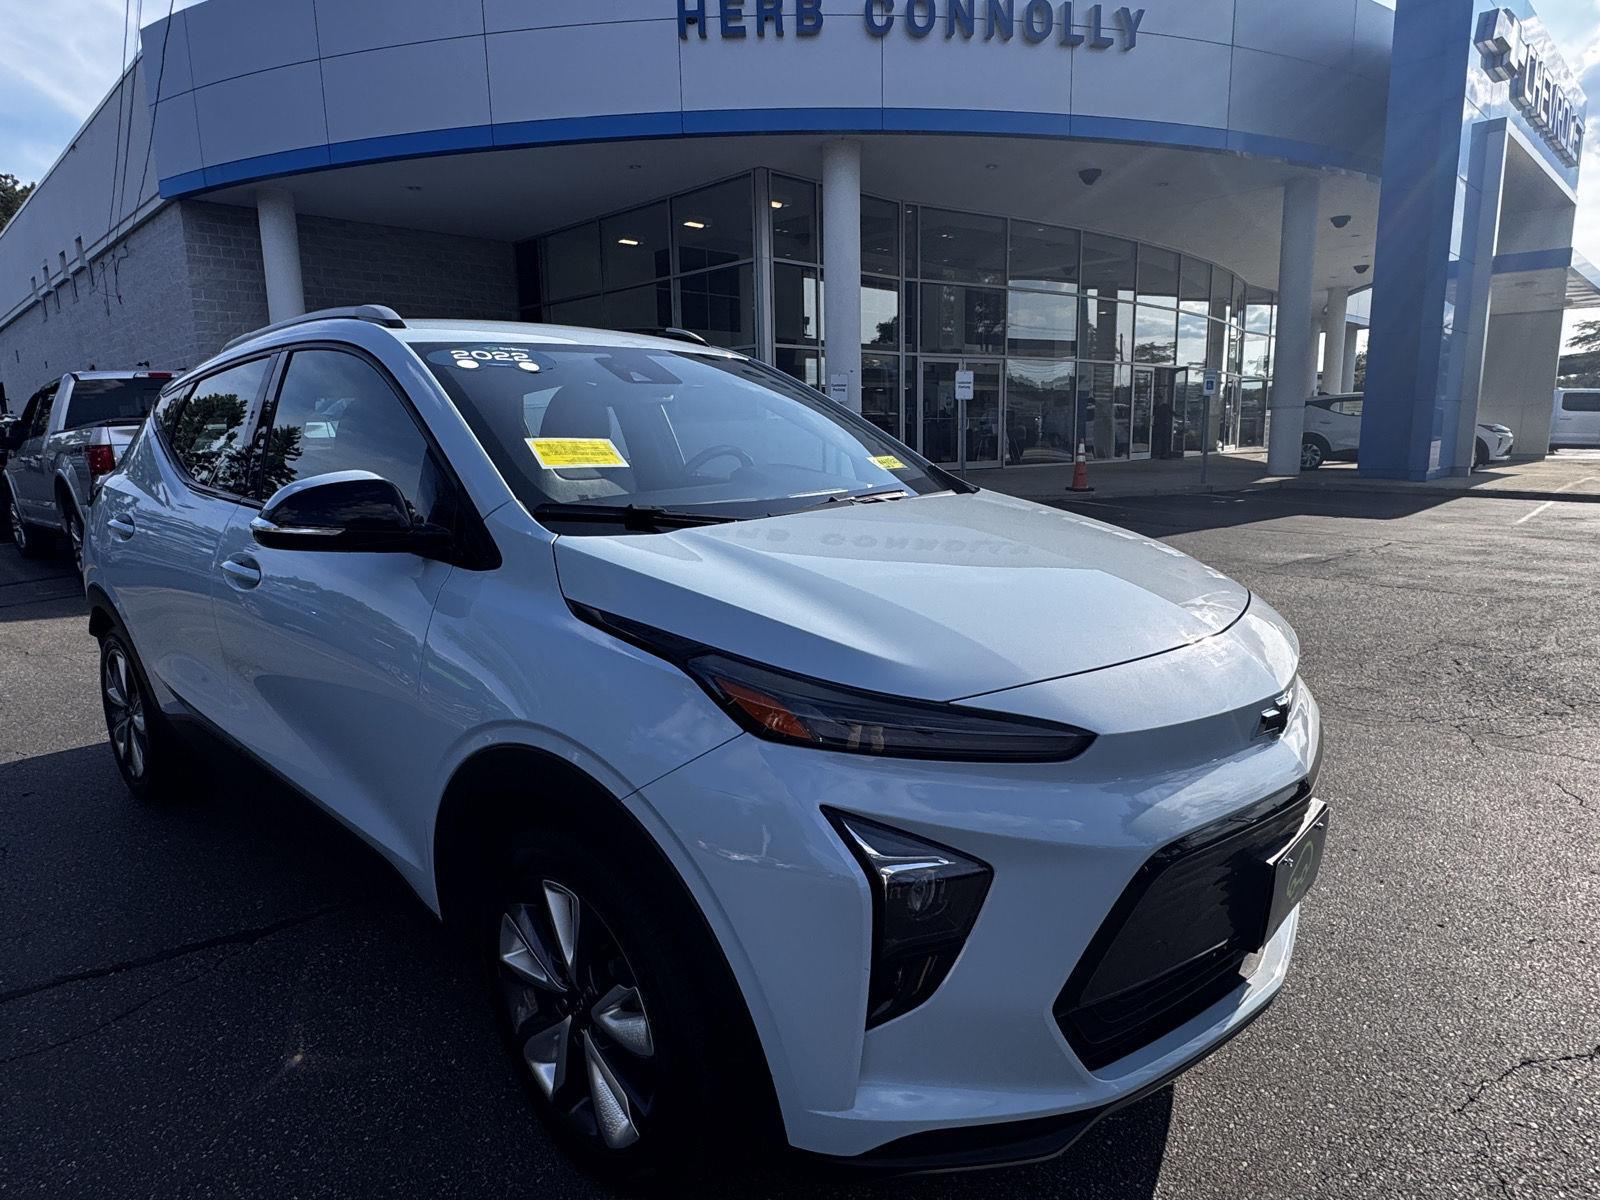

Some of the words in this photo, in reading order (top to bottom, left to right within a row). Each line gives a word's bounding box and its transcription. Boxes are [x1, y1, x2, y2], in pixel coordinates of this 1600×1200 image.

[677, 0, 824, 40] HERB
[864, 0, 1146, 52] CONNOLLY
[450, 350, 532, 361] 2022
